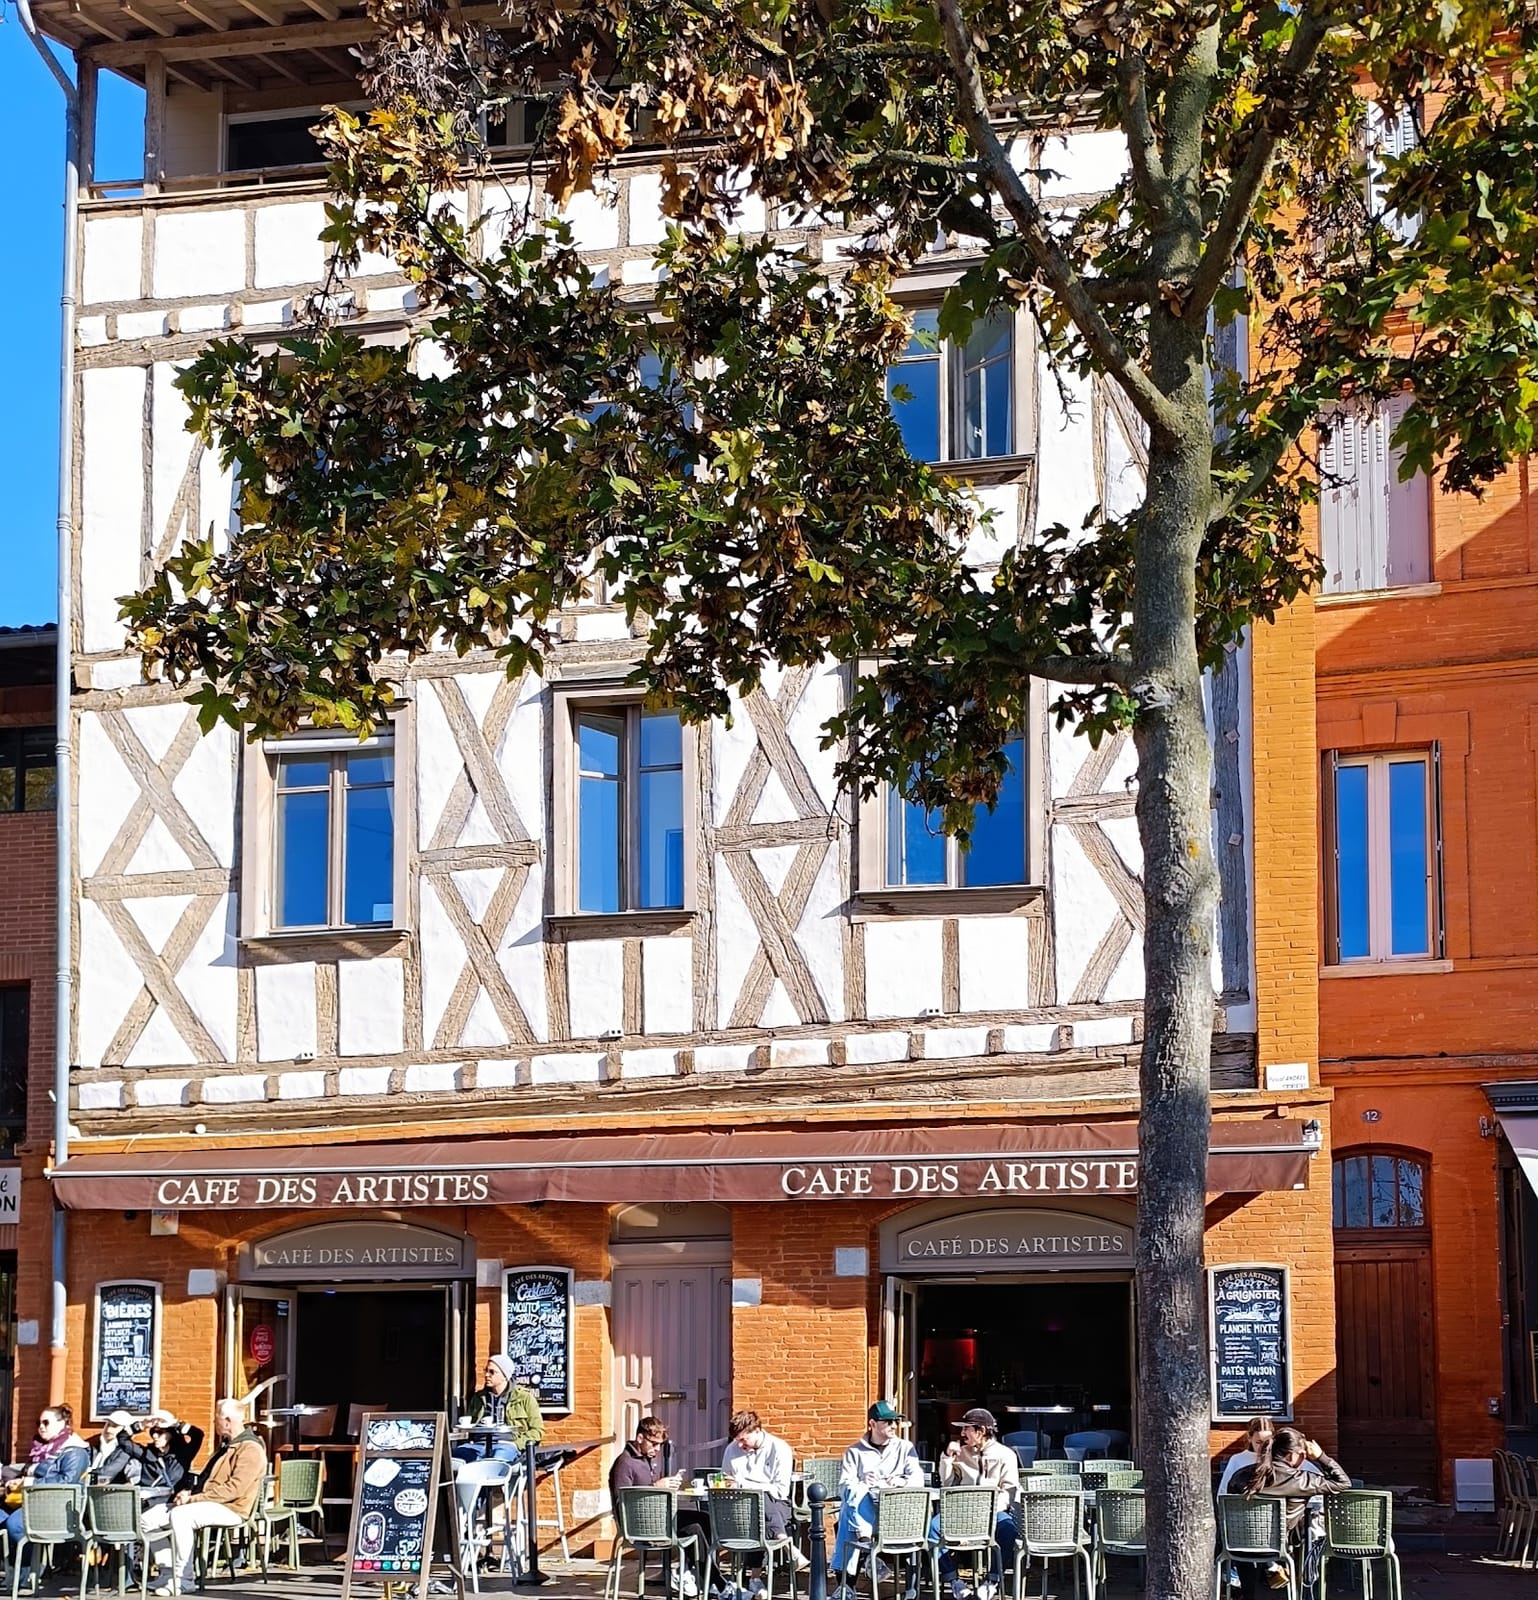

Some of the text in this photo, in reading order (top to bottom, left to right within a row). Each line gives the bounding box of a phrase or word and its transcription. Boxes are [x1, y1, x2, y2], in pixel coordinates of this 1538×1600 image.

[1366, 1111, 1378, 1121] 12
[781, 1160, 1139, 1195] CAFE DES ARTISTE
[157, 1174, 490, 1205] CAFE DES ARTISTES
[907, 1235, 1124, 1256] CAFÉ DES ARTISTES
[263, 1244, 455, 1265] CAFÉ DES ARTISTES
[538, 1274, 564, 1287] ARTISTES
[1218, 1272, 1280, 1287] CAFÉ DES ARTISTES
[1216, 1287, 1281, 1303] À GRIGNOTER
[104, 1301, 152, 1319] BIÈRES
[1219, 1323, 1279, 1334] PLANCHE MIXTE
[1221, 1365, 1276, 1376] PATÉS MAISON
